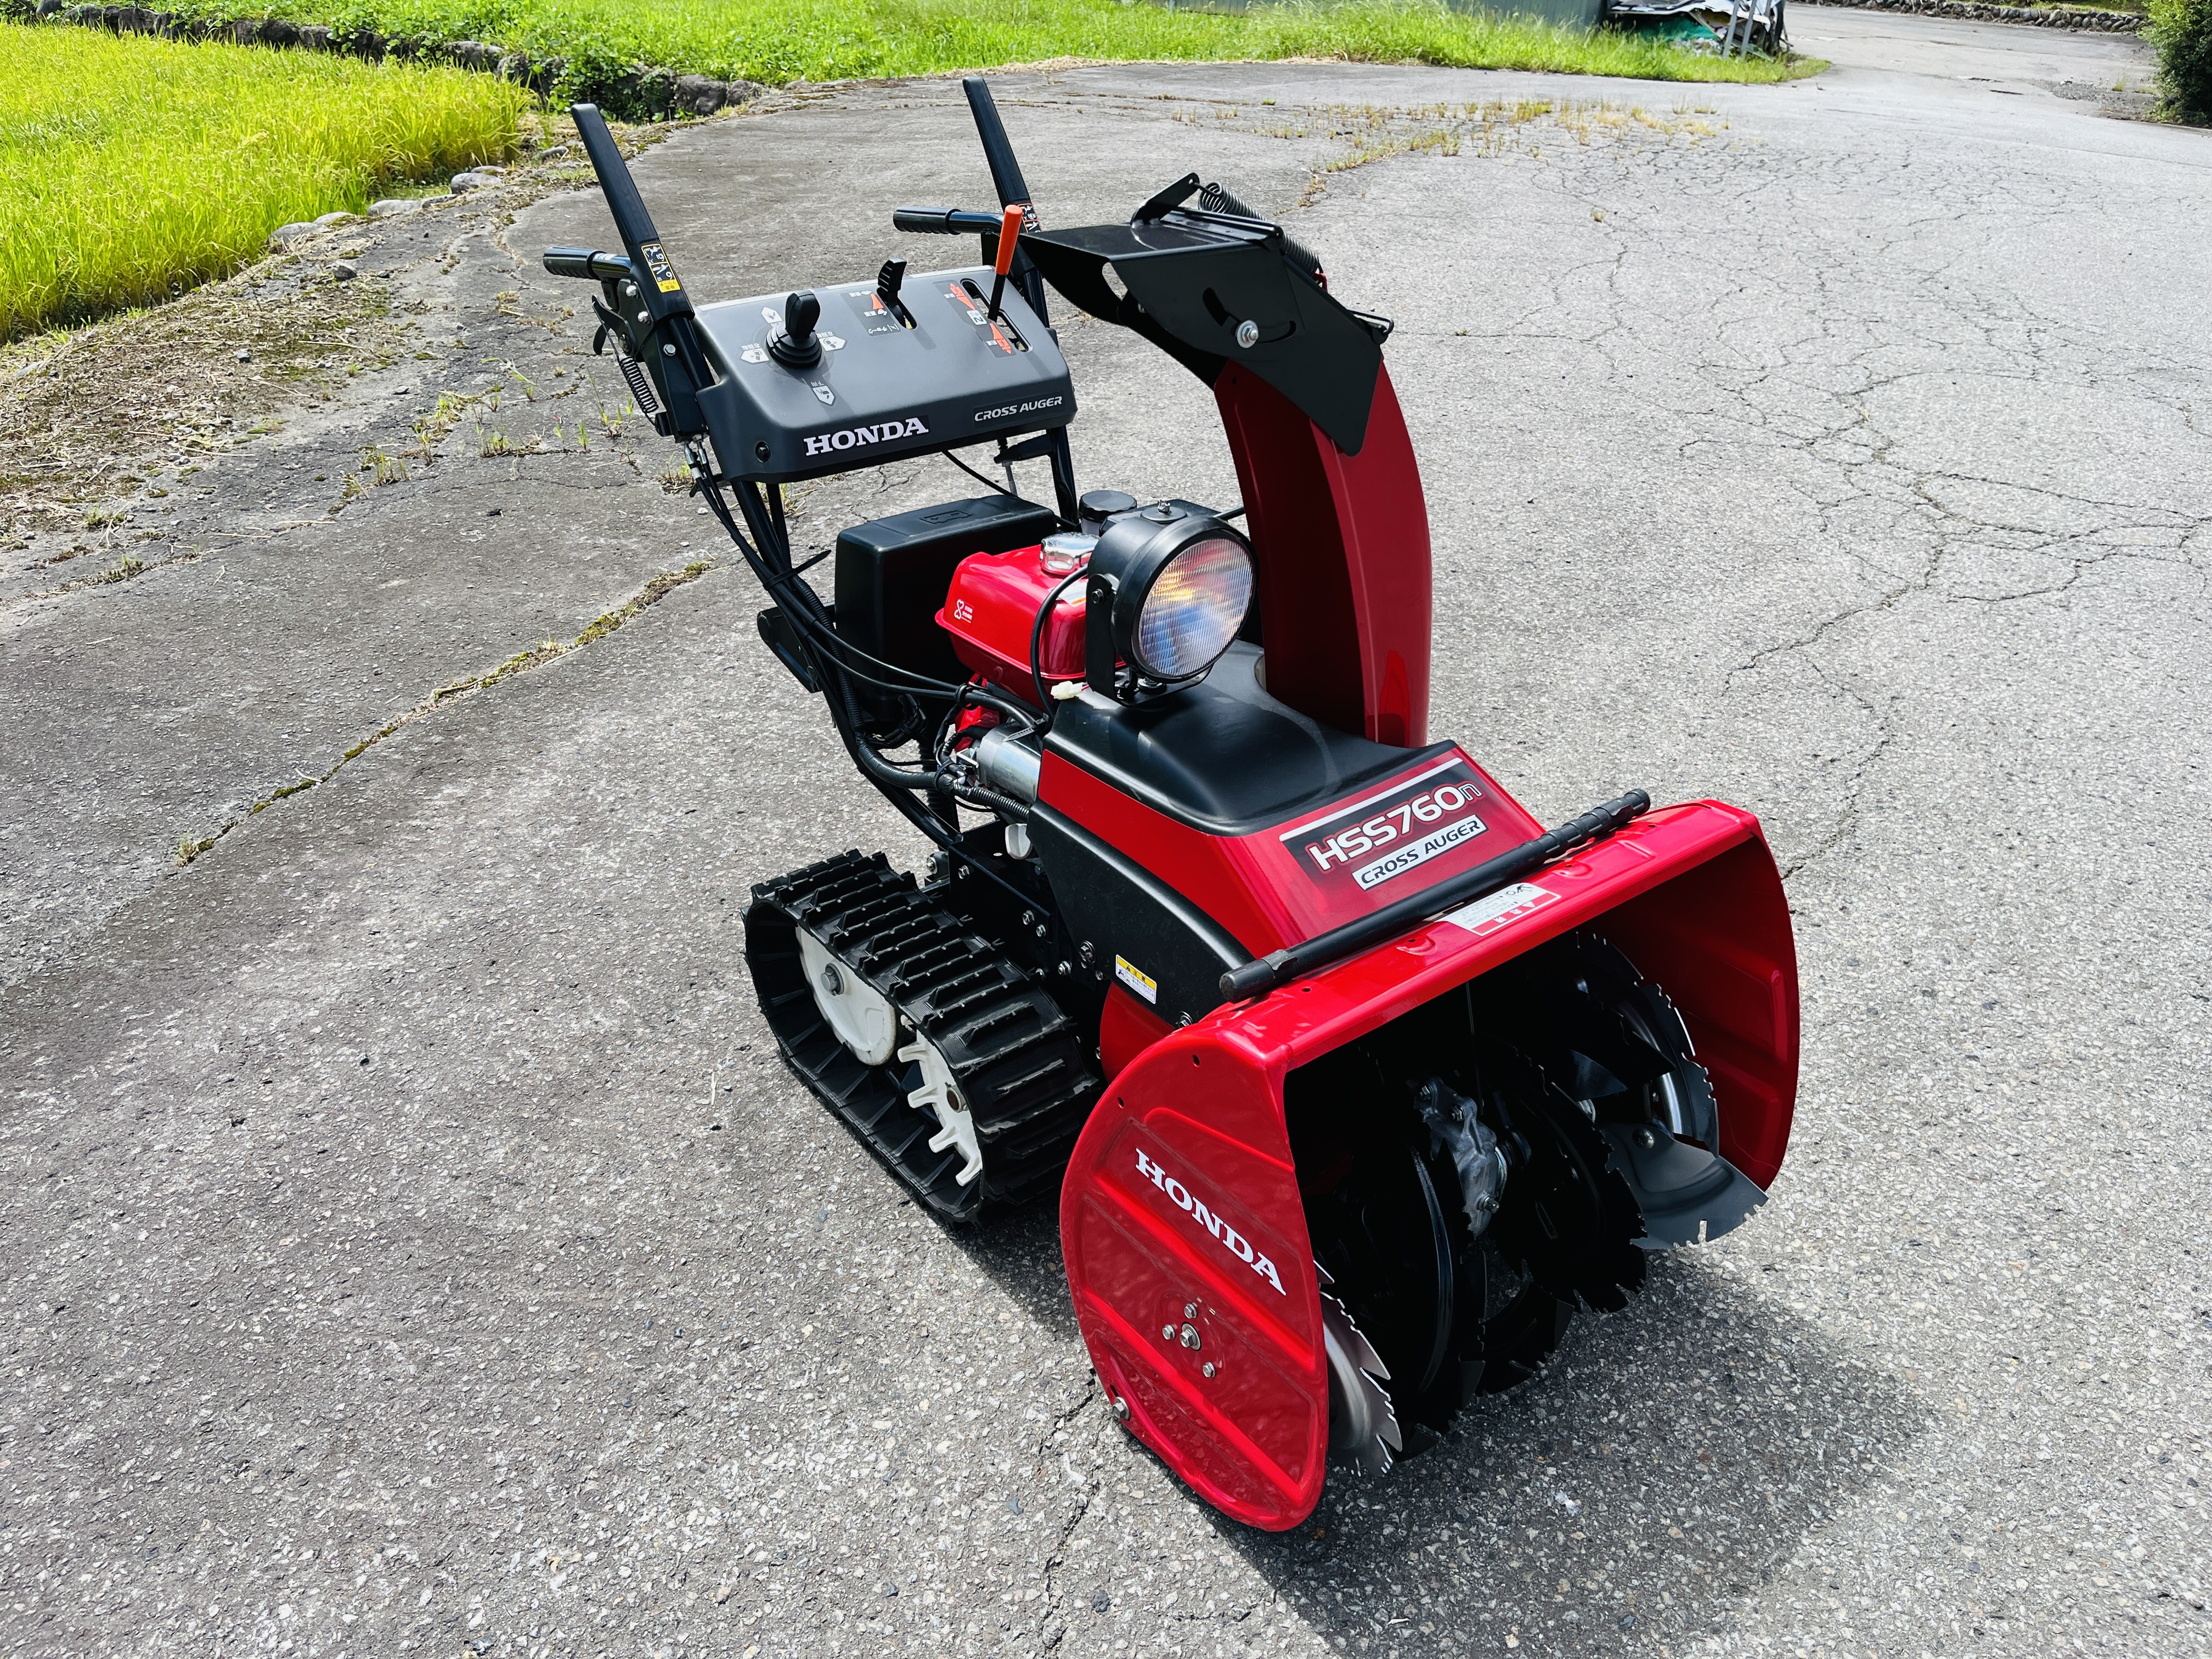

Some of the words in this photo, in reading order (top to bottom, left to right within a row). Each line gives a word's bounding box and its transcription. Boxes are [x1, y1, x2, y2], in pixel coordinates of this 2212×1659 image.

[803, 417, 929, 456] HONDA
[974, 405, 1018, 422] CROSS
[1019, 396, 1063, 413] AUGER
[1309, 783, 1482, 870] HSS760n
[1361, 849, 1419, 884] CROSS
[1425, 820, 1481, 854] AUGER
[1136, 1148, 1286, 1296] HONDA
